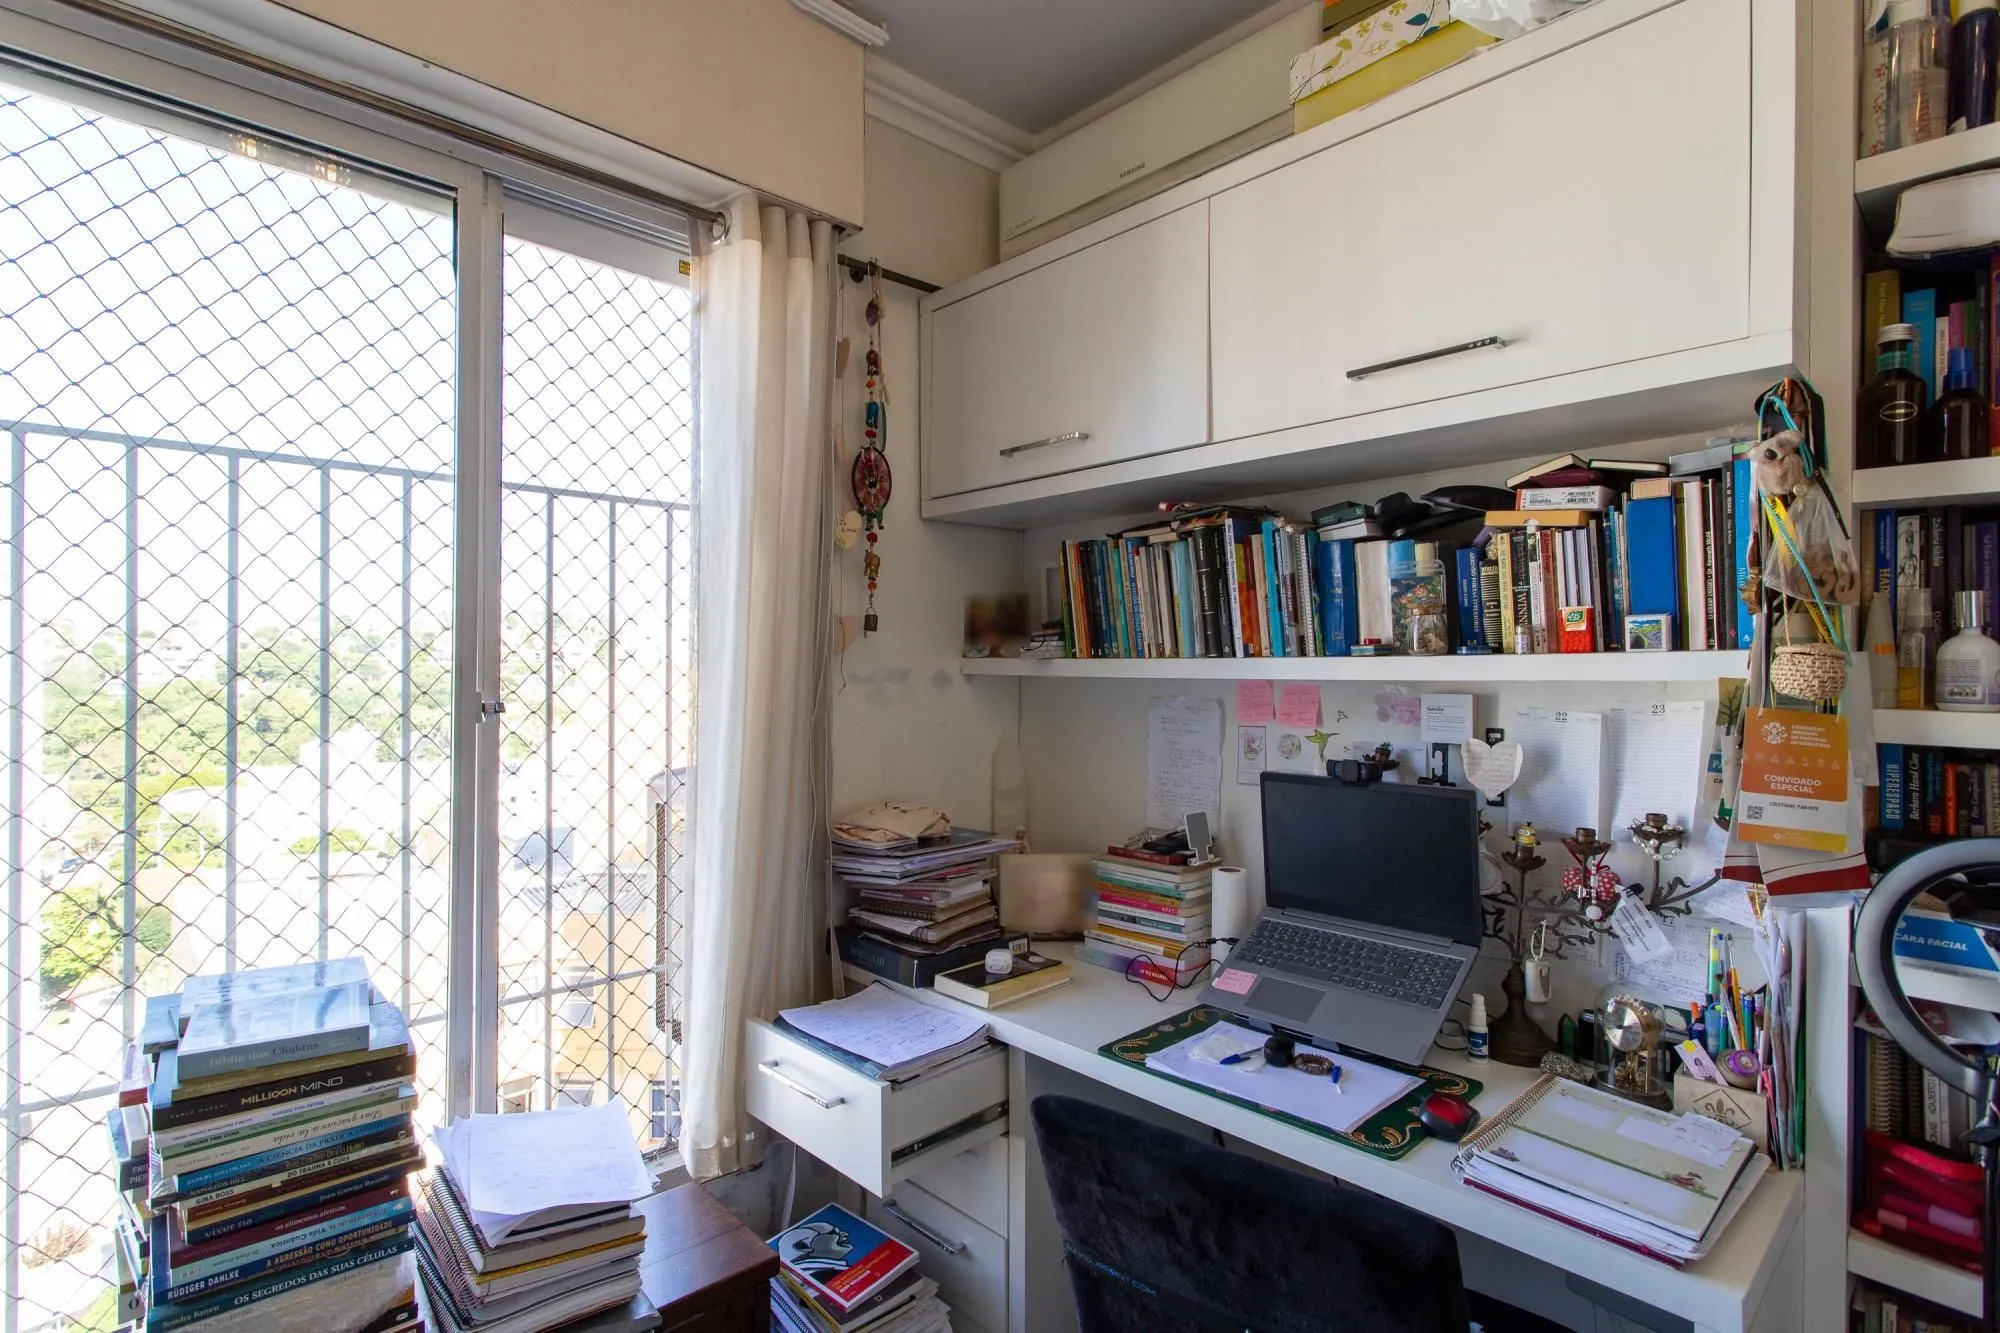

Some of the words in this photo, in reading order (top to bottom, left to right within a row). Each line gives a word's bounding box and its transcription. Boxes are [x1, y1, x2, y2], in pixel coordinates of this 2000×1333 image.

[1119, 162, 1146, 179] SAMSUNG
[1555, 711, 1568, 721] 22
[1651, 704, 1666, 714] 23
[1764, 774, 1822, 787] CONVIDADO
[1770, 783, 1815, 794] ESPECIAL
[1769, 801, 1796, 809] CRISTIANE
[1926, 938, 1968, 951] FACIAL
[248, 1049, 270, 1061] dos
[271, 1041, 320, 1056] Chakras
[300, 1076, 343, 1093] MIND
[322, 1113, 358, 1127] gracias
[360, 1110, 383, 1121] Dar
[272, 1131, 295, 1144] vida
[298, 1129, 309, 1139] la
[287, 1168, 298, 1178] DO
[299, 1161, 326, 1176] TRAUMA
[333, 1155, 351, 1165] CURA
[195, 1194, 214, 1205] GINA
[215, 1189, 234, 1200] ROSS
[275, 1224, 285, 1232] os
[284, 1214, 319, 1229] alimentos
[318, 1205, 347, 1218] afetivos
[204, 1223, 236, 1238] viver
[308, 1227, 327, 1237] Vida
[266, 1258, 273, 1268] A
[274, 1245, 313, 1265] AGRESSÃO
[315, 1238, 336, 1251] COMO
[338, 1220, 393, 1243] OPORTUNIDADE
[234, 1294, 249, 1305] OS
[251, 1276, 307, 1300] SEGREDOS
[309, 1268, 329, 1281] DAS
[330, 1260, 355, 1274] SUAS
[357, 1246, 398, 1265] CÉLULAS
[167, 1280, 206, 1300] RÜDIGER
[207, 1269, 240, 1287] DAHLKE
[162, 1315, 192, 1329] Sondra
[193, 1304, 220, 1318] Barrett
